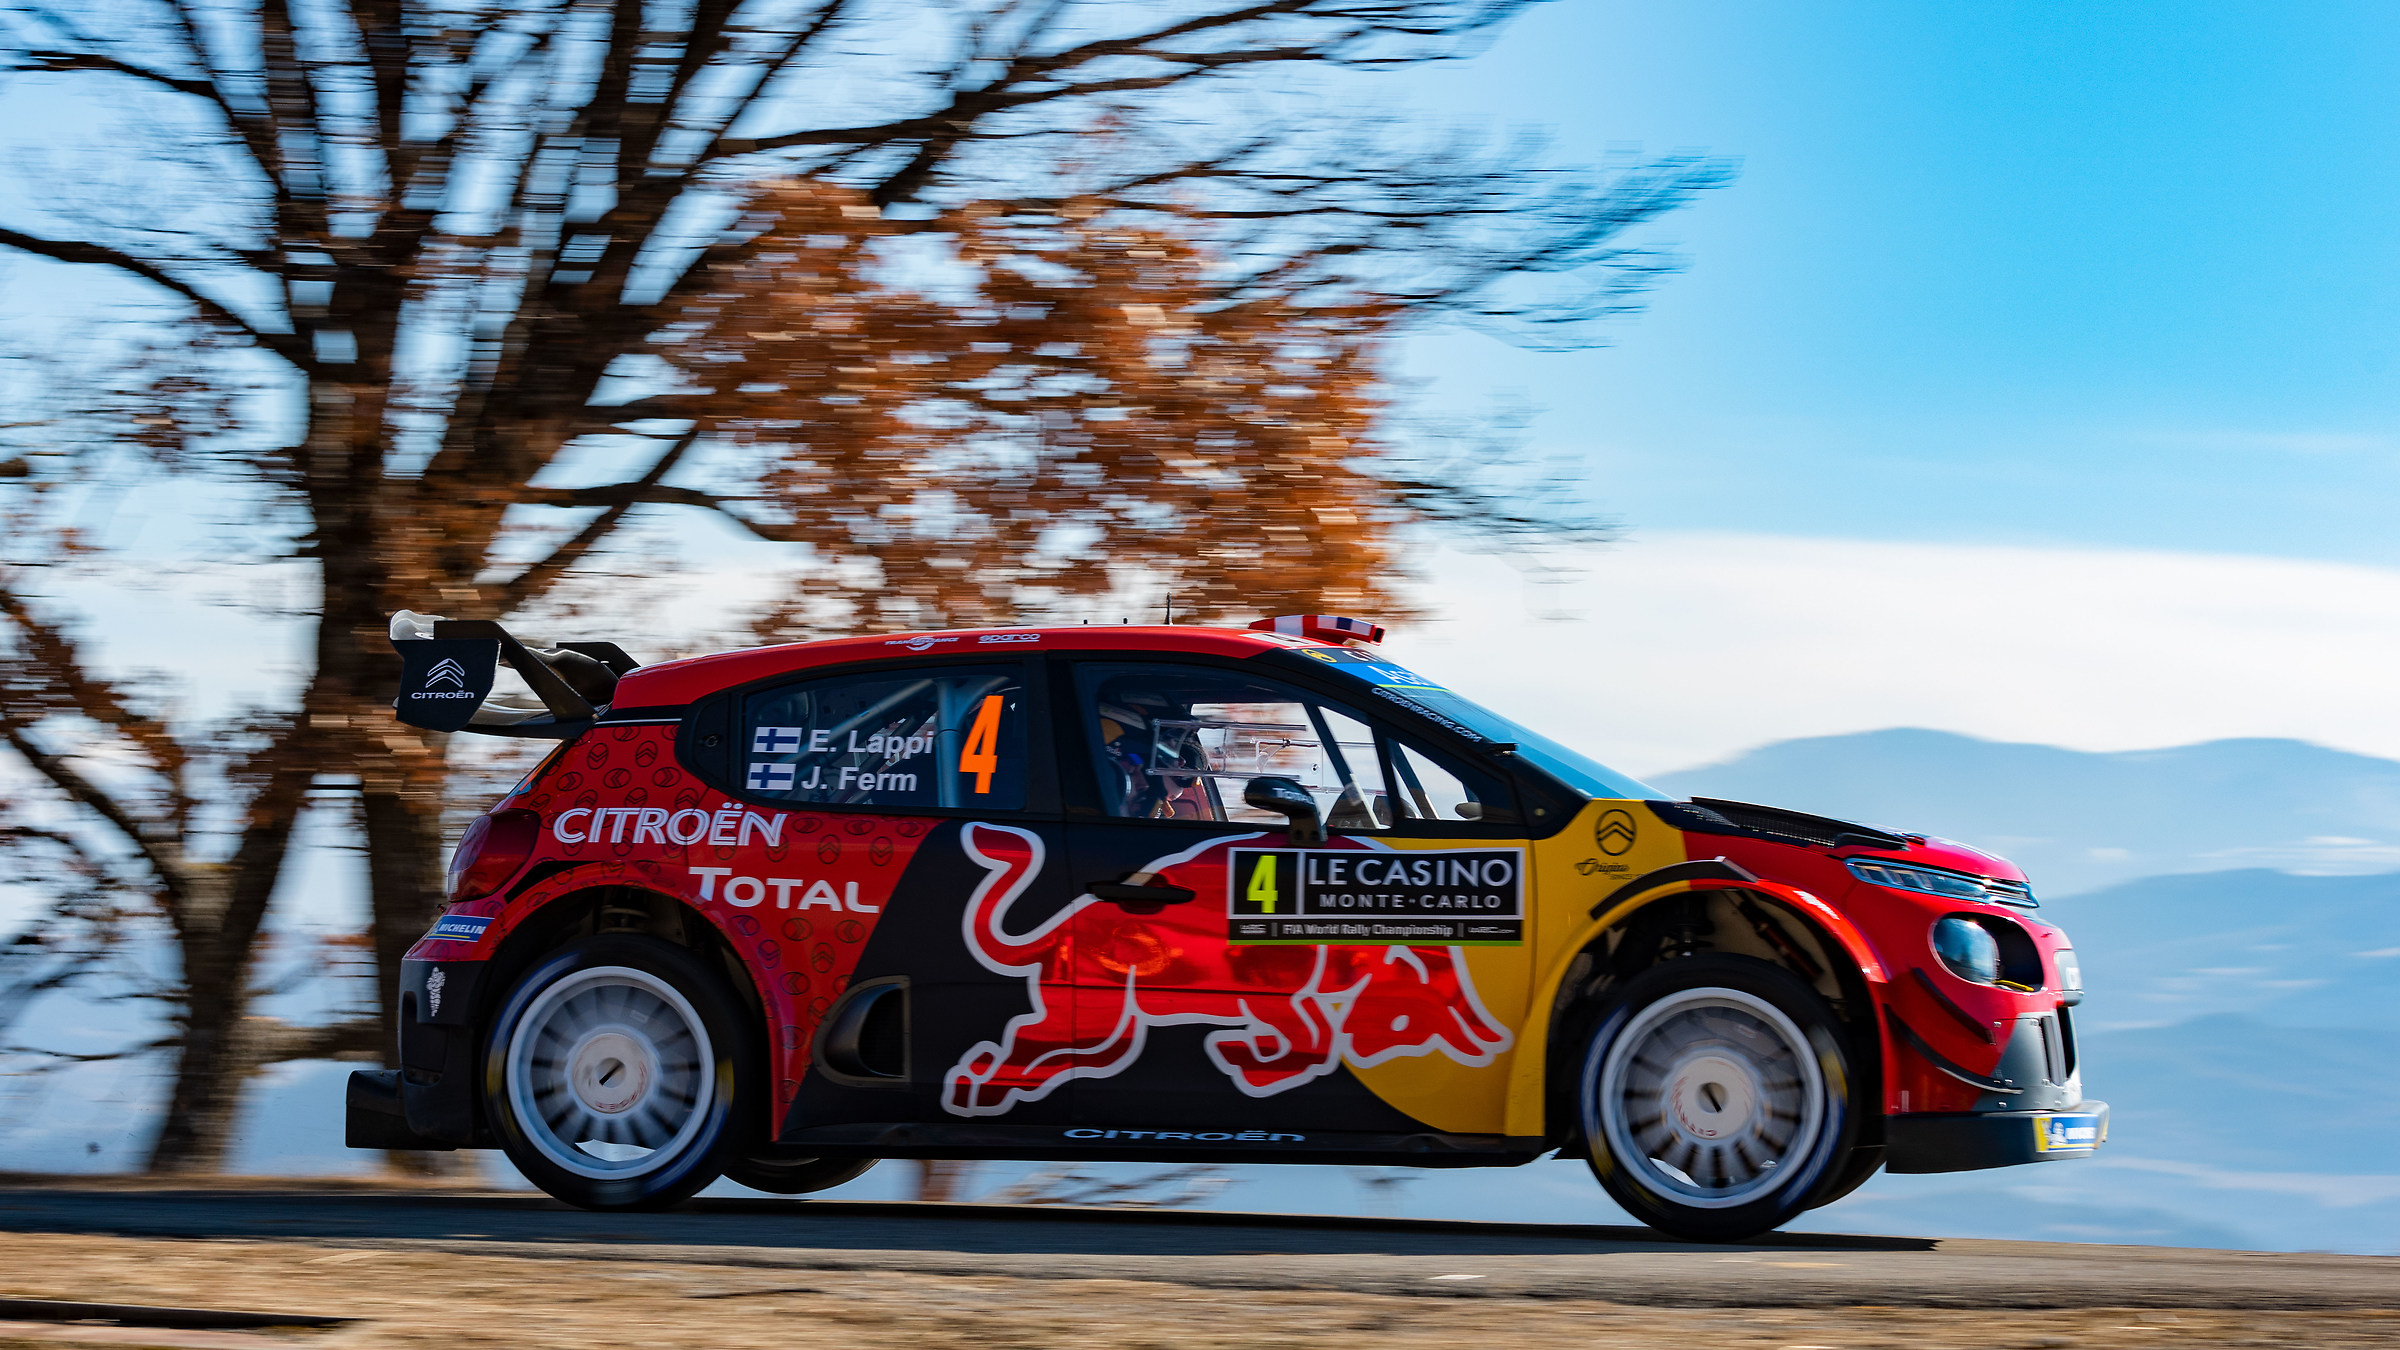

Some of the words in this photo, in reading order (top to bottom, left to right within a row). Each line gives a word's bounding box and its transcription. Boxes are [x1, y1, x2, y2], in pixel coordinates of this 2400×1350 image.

[979, 633, 1041, 643] sparco
[807, 729, 837, 753] E.
[847, 730, 934, 760] Lappi
[959, 695, 1004, 794] 4
[801, 766, 828, 790] J.
[838, 766, 917, 792] Ferm
[553, 802, 788, 847] CITROËN
[1246, 855, 1279, 914] 4
[1308, 858, 1349, 886] LE
[1355, 859, 1514, 887] CASINO
[688, 866, 880, 914] TOTAL
[1319, 894, 1405, 908] MONTE
[1420, 894, 1501, 909] CARLO
[439, 923, 487, 935] MICHELIN
[1282, 924, 1304, 935] FIA
[1304, 924, 1340, 935] World
[1340, 924, 1371, 937] Rally
[1372, 924, 1454, 937] Championship
